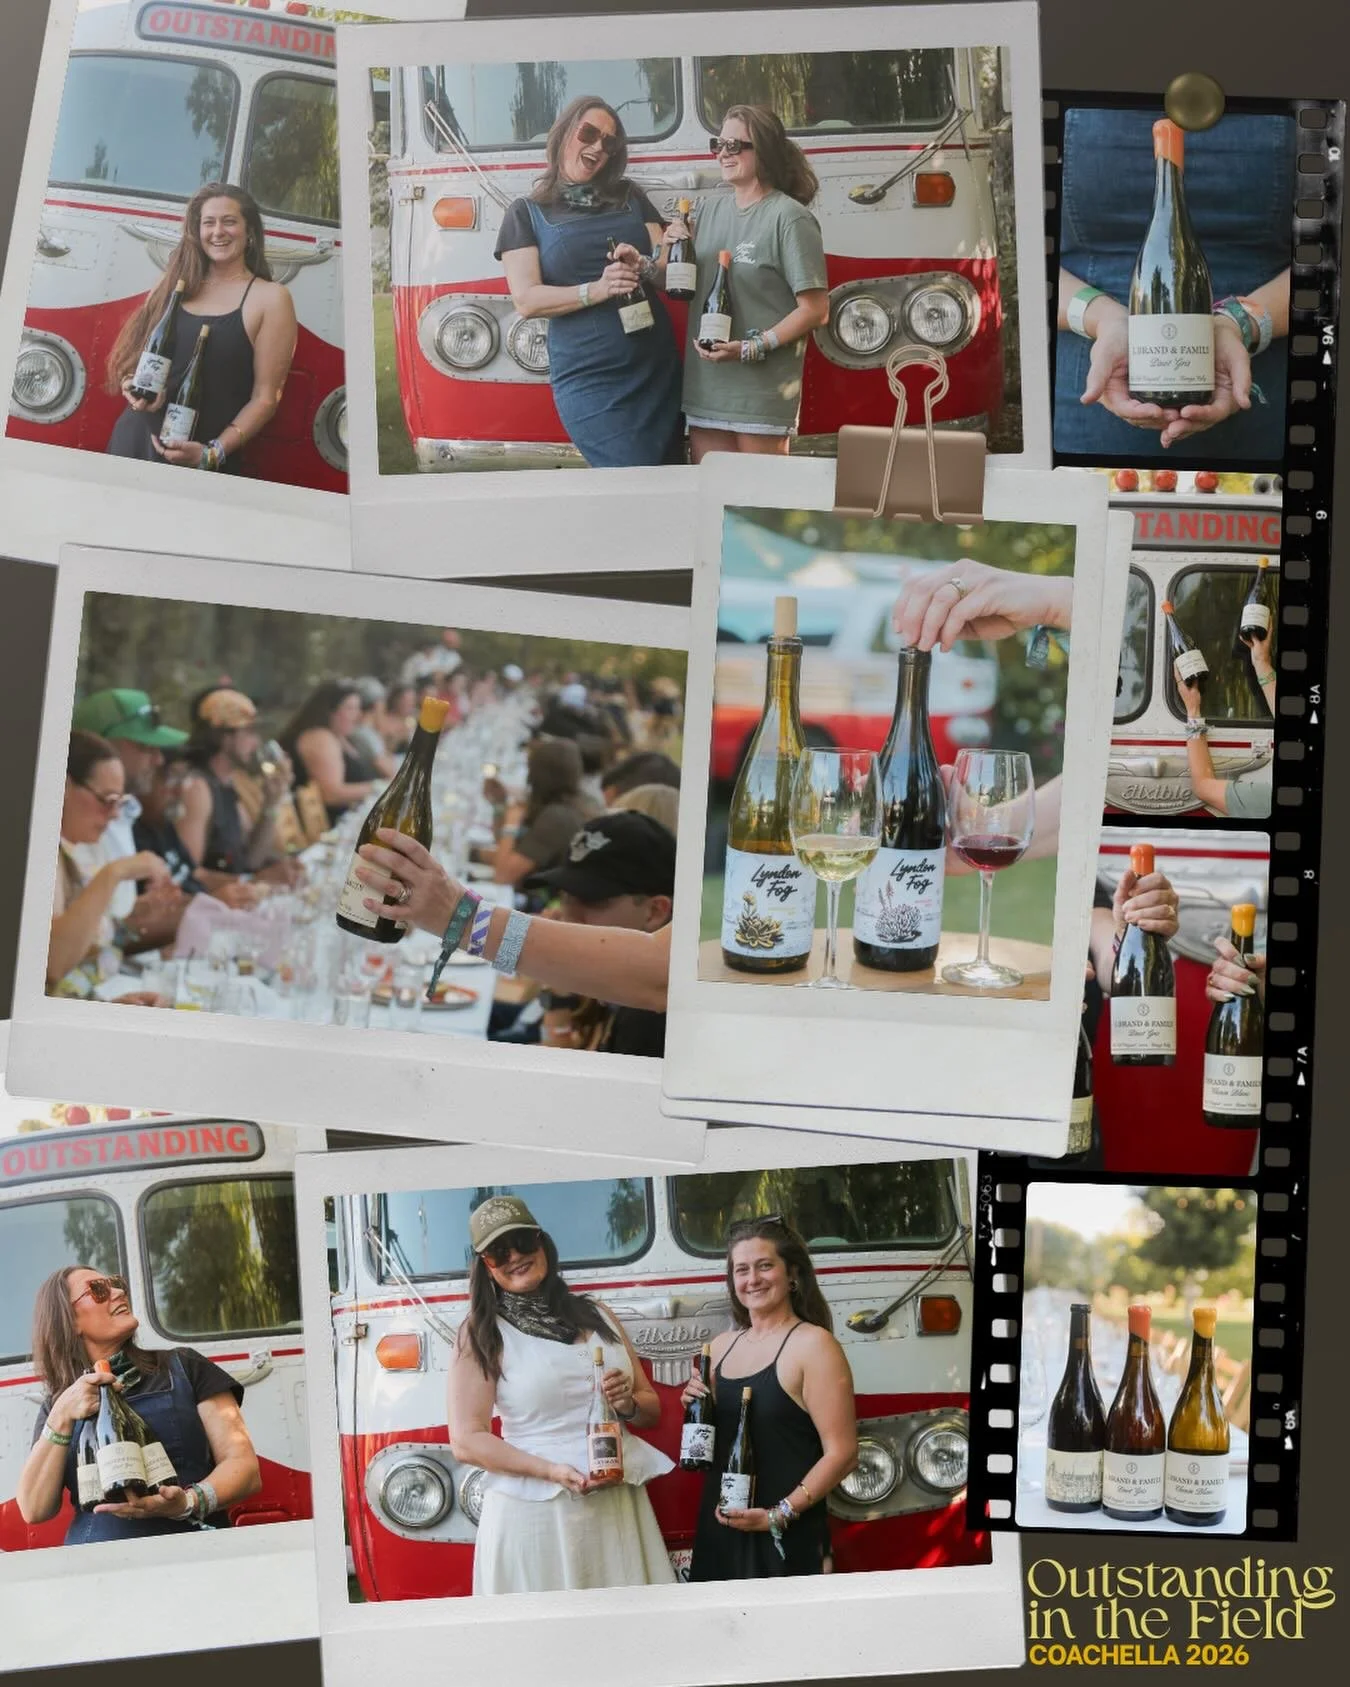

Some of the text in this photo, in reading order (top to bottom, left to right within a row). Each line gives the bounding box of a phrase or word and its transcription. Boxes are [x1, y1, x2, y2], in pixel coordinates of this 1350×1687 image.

[1328, 147, 1341, 161] 10
[1322, 324, 1335, 345] 9A
[1315, 510, 1328, 520] 9
[1134, 511, 1281, 545] TANDING
[1309, 684, 1321, 704] 8A
[750, 863, 803, 889] Lyndon
[890, 857, 937, 883] Lyndon
[1303, 869, 1315, 880] 8
[766, 879, 799, 903] Fog
[905, 874, 934, 896] Fog
[3, 1126, 250, 1177] OUTSTANDING
[980, 1174, 993, 1212] 5063
